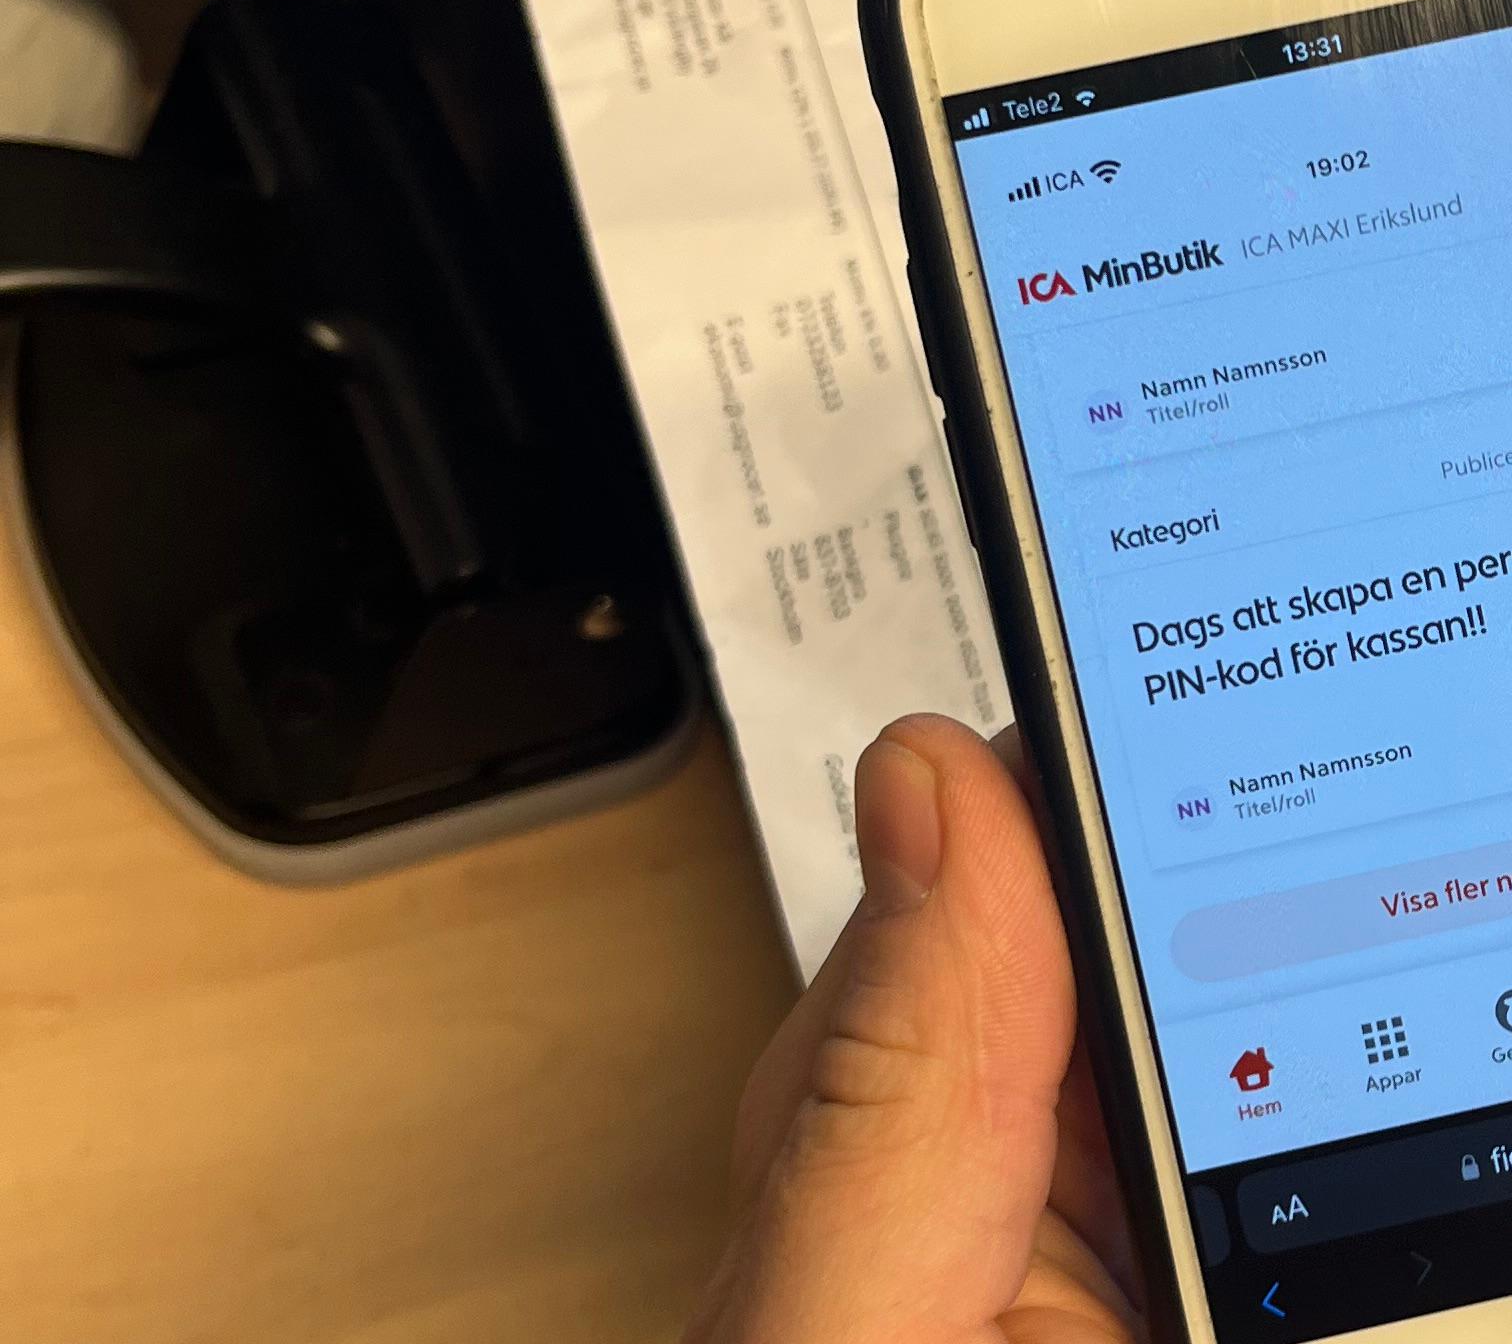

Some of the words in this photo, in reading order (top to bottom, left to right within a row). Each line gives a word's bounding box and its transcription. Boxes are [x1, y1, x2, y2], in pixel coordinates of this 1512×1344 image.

[1281, 33, 1344, 65] 13:31
[1002, 92, 1065, 122] Tele2
[1045, 168, 1085, 194] ICA
[1305, 150, 1371, 180] 19:02
[1018, 270, 1078, 306] ICA
[1082, 238, 1224, 293] MinButik
[1240, 232, 1284, 260] ICA
[1288, 216, 1352, 251] MAXI
[1356, 193, 1465, 237] Erikslund
[1141, 370, 1209, 402] Namn
[1212, 347, 1329, 386] Namnsson
[1088, 401, 1124, 425] NN
[1146, 392, 1232, 426] Titel/roll
[1109, 507, 1220, 552] Kategori
[1131, 611, 1225, 657] Dags
[1232, 596, 1282, 630] att
[1288, 575, 1394, 617] skapa
[1401, 565, 1447, 595] en
[1143, 649, 1285, 706] PIN-kod
[1291, 637, 1338, 676] för
[1346, 603, 1489, 662] kassan!!
[1228, 766, 1294, 797] Namn
[1299, 742, 1414, 781] Namnsson
[1176, 797, 1213, 822] NN
[1233, 787, 1318, 821] Titel/roll
[1381, 888, 1440, 919] Visa
[1443, 875, 1489, 906] fler
[1364, 1065, 1424, 1095] Appar
[1236, 1096, 1284, 1123] Hem
